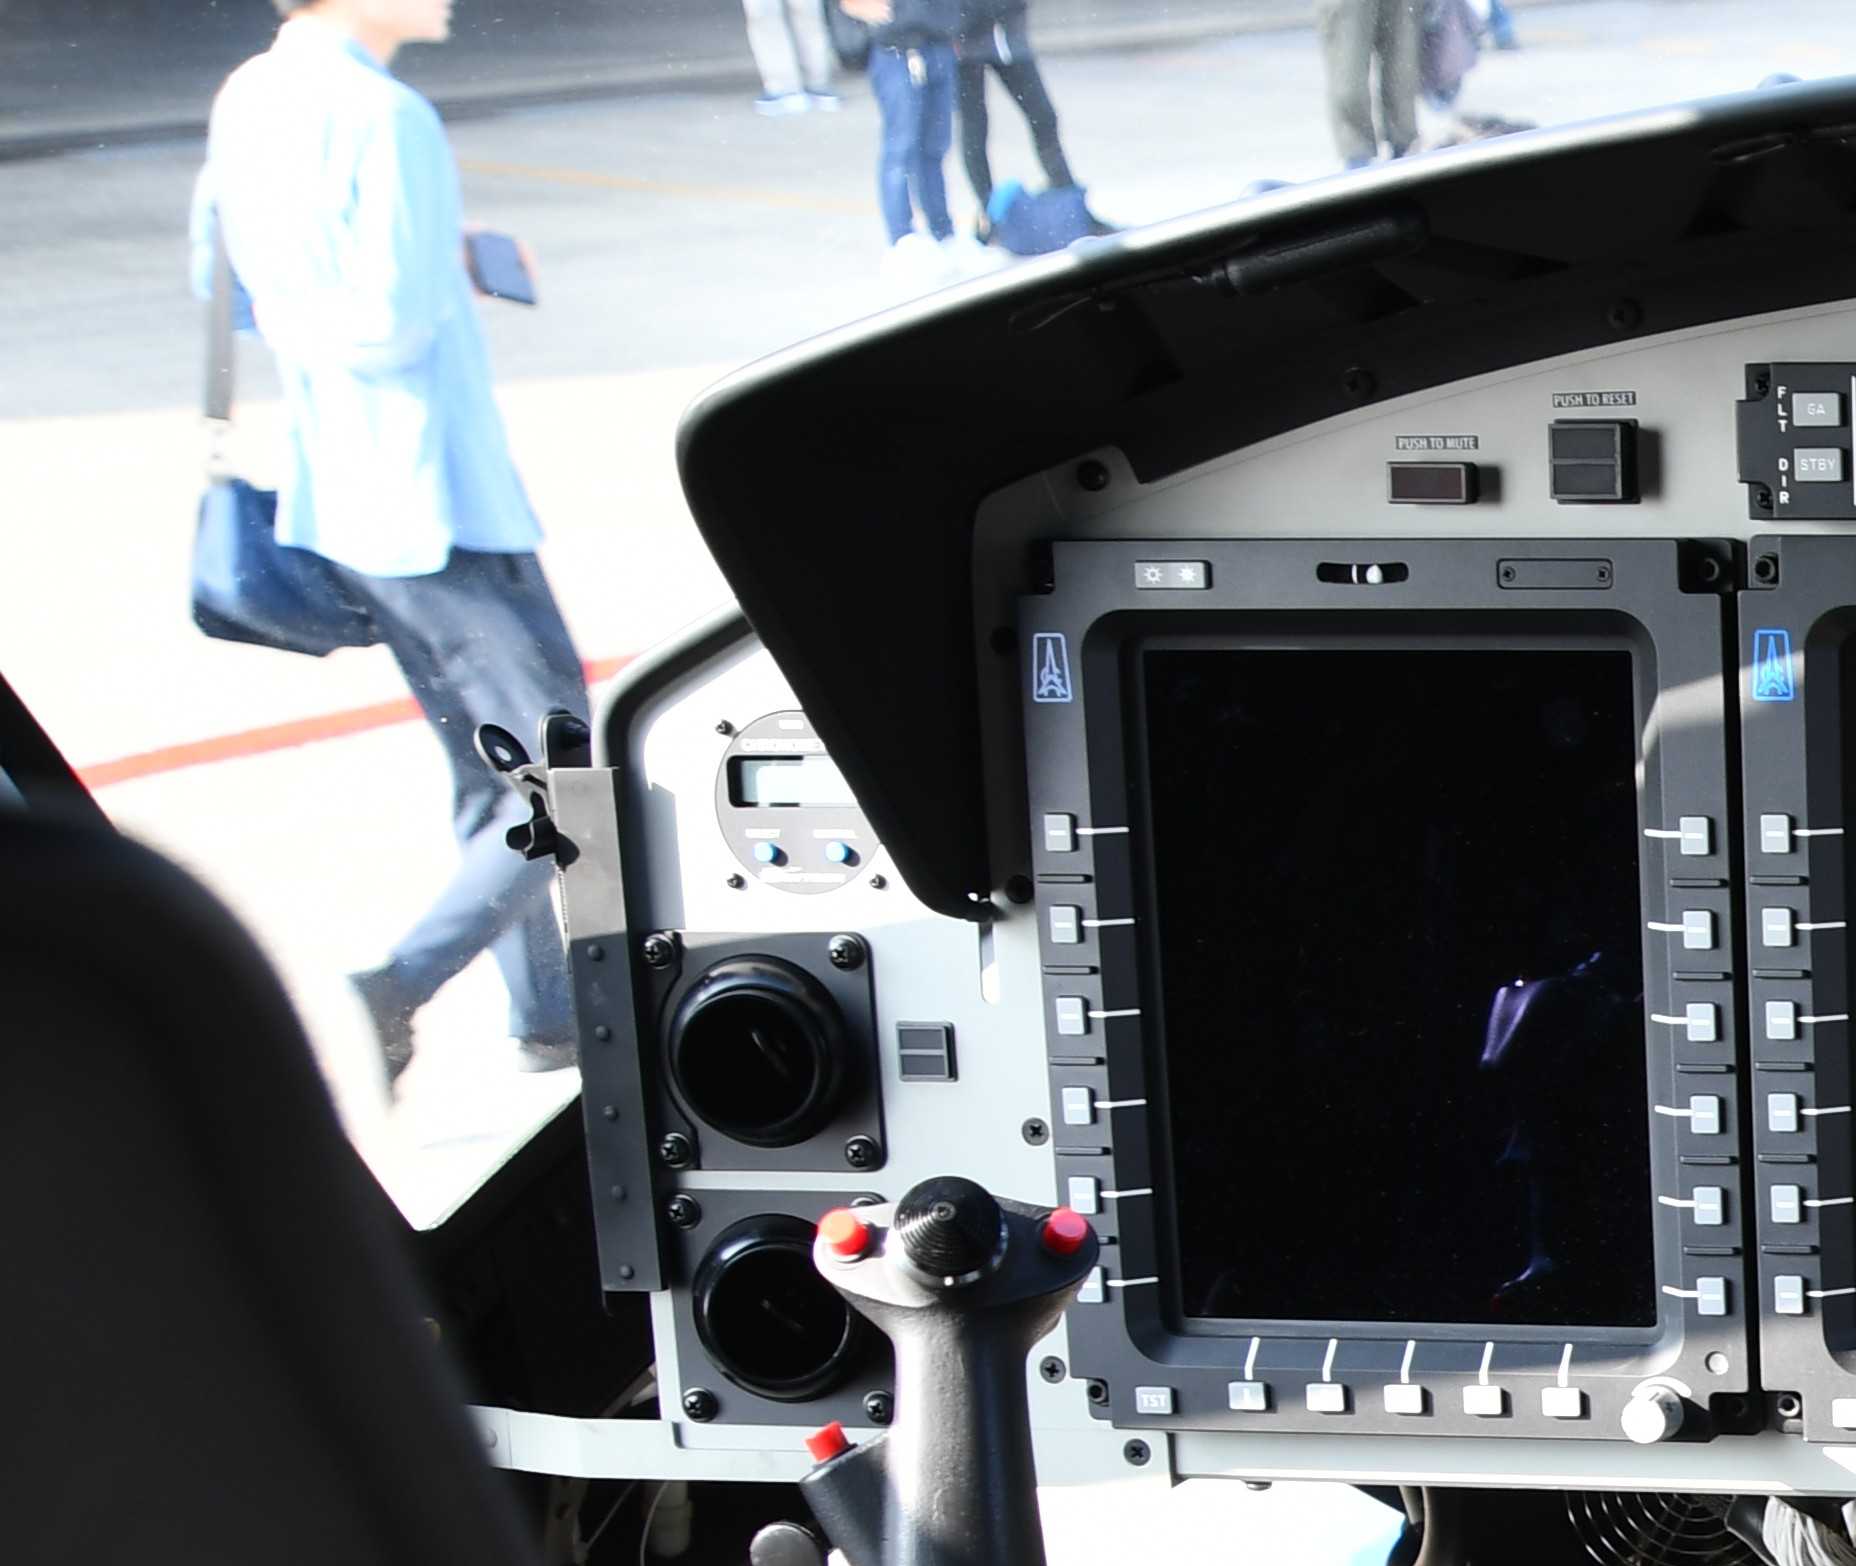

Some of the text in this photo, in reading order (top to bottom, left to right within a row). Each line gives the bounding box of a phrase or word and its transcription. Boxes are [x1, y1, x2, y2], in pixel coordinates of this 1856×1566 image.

[1554, 392, 1634, 407] PUSH TO RESET
[1398, 438, 1475, 449] PUSH TO MUTE
[1801, 459, 1835, 472] STBY
